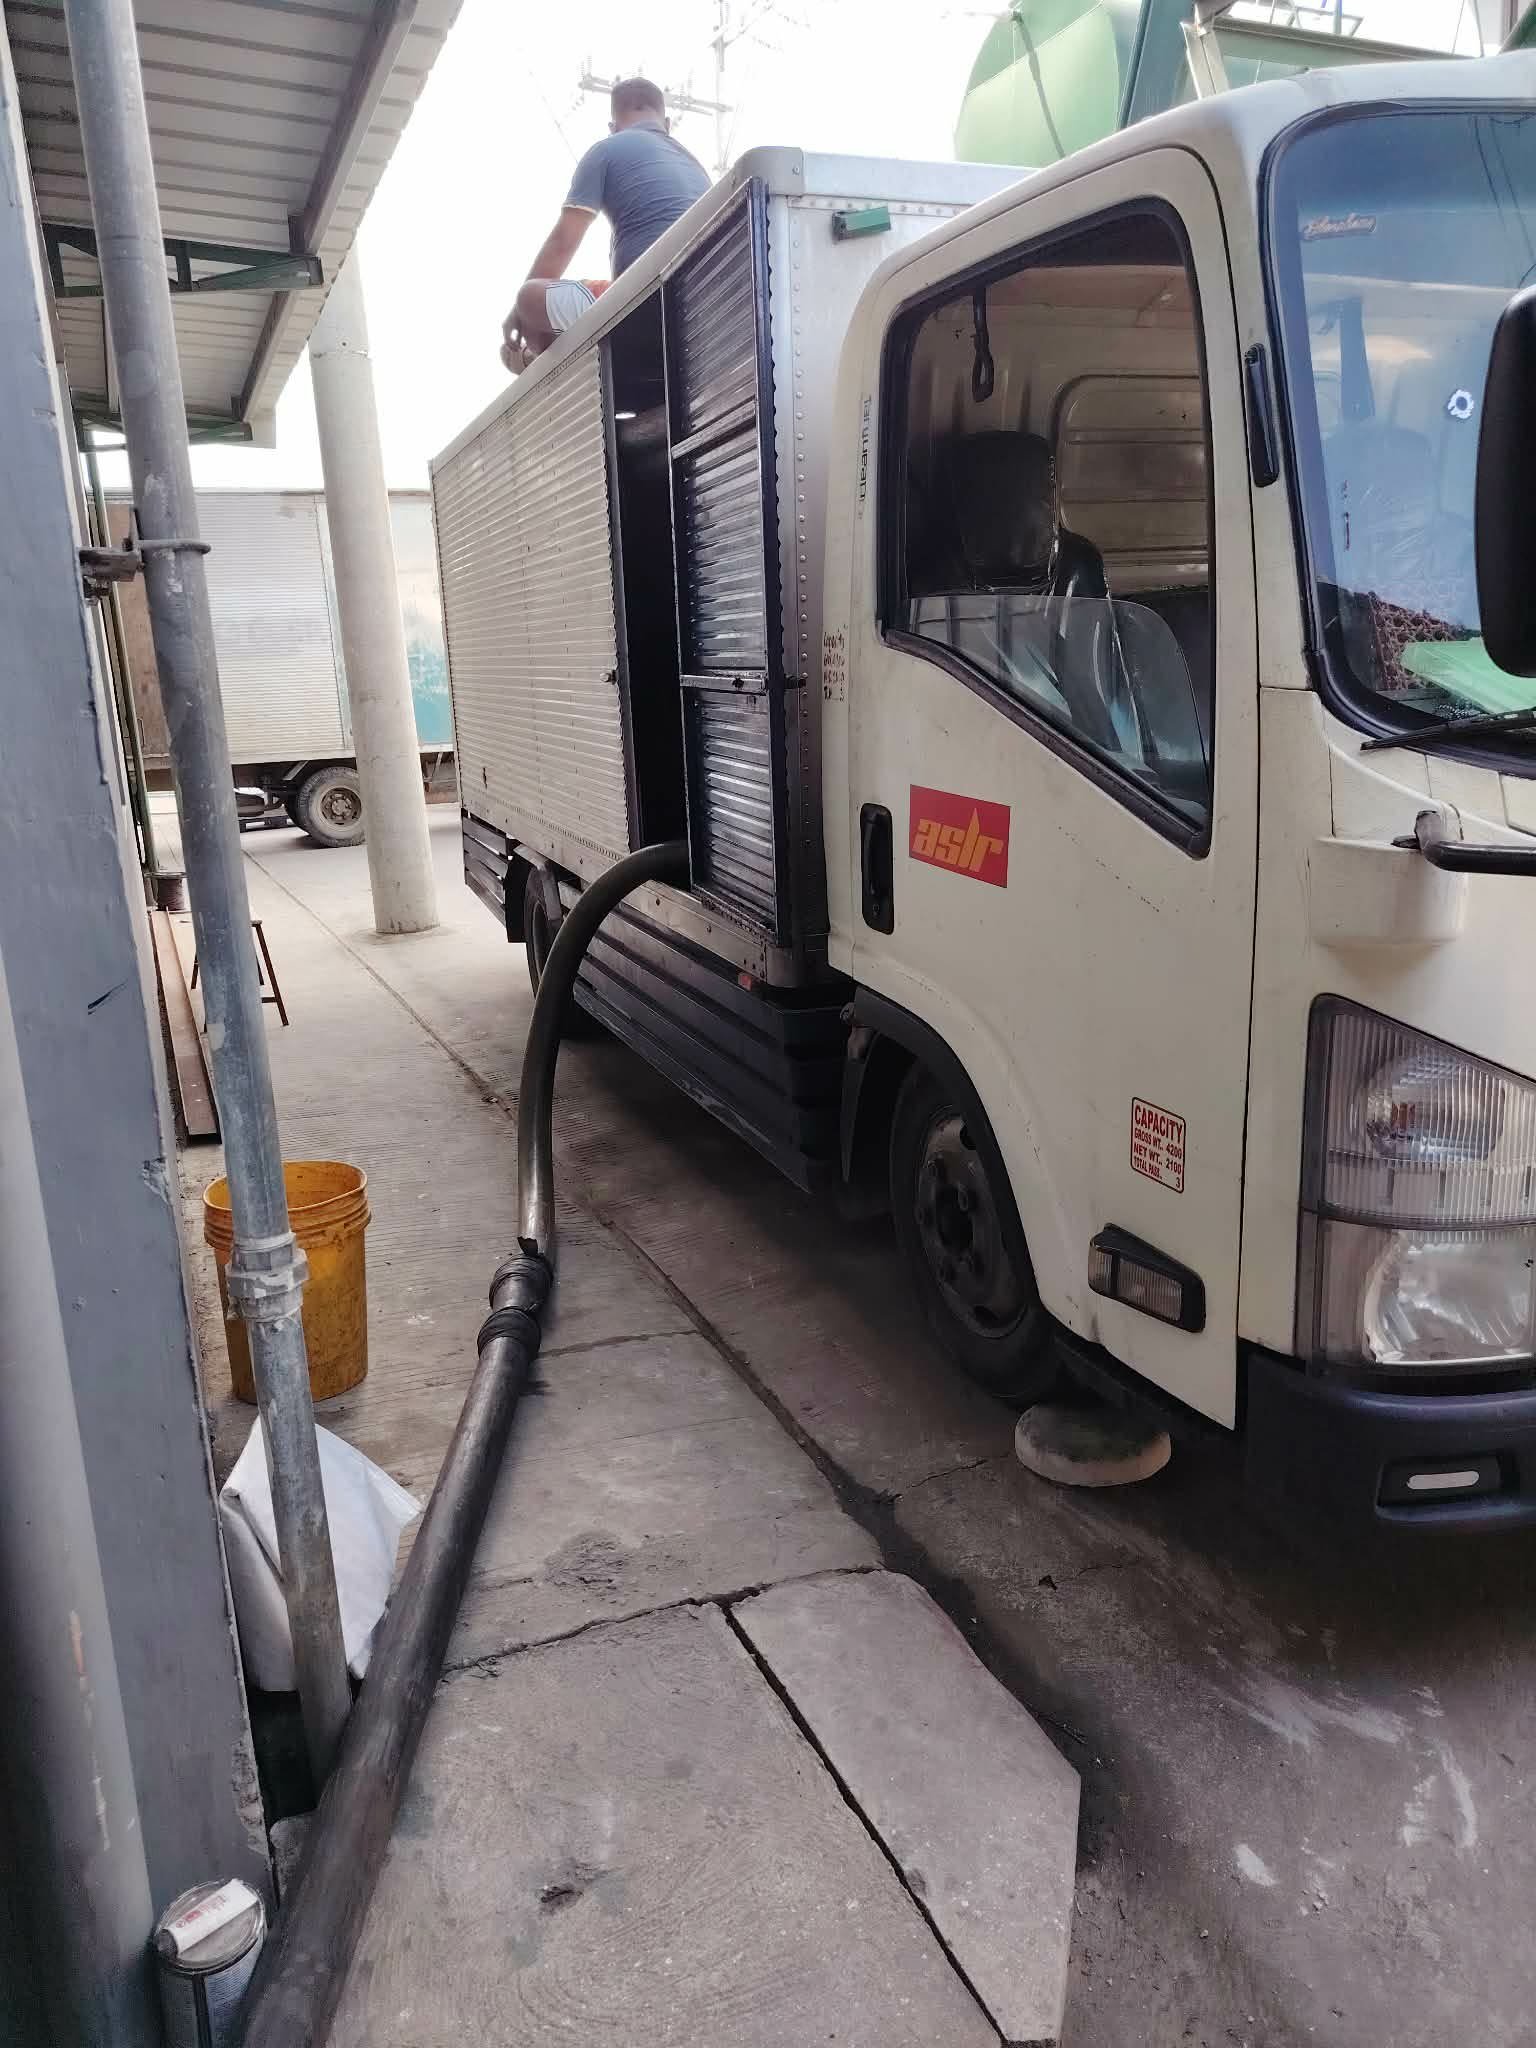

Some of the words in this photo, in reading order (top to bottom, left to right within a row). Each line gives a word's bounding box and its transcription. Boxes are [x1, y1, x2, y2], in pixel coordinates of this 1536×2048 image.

[1134, 1104, 1183, 1144] CAPACITY
[1134, 1127, 1152, 1145] GROSS
[1133, 1142, 1148, 1157] NET
[1166, 1158, 1182, 1175] 2100
[1133, 1156, 1148, 1172] TOTAL
[1175, 1176, 1181, 1188] 3
